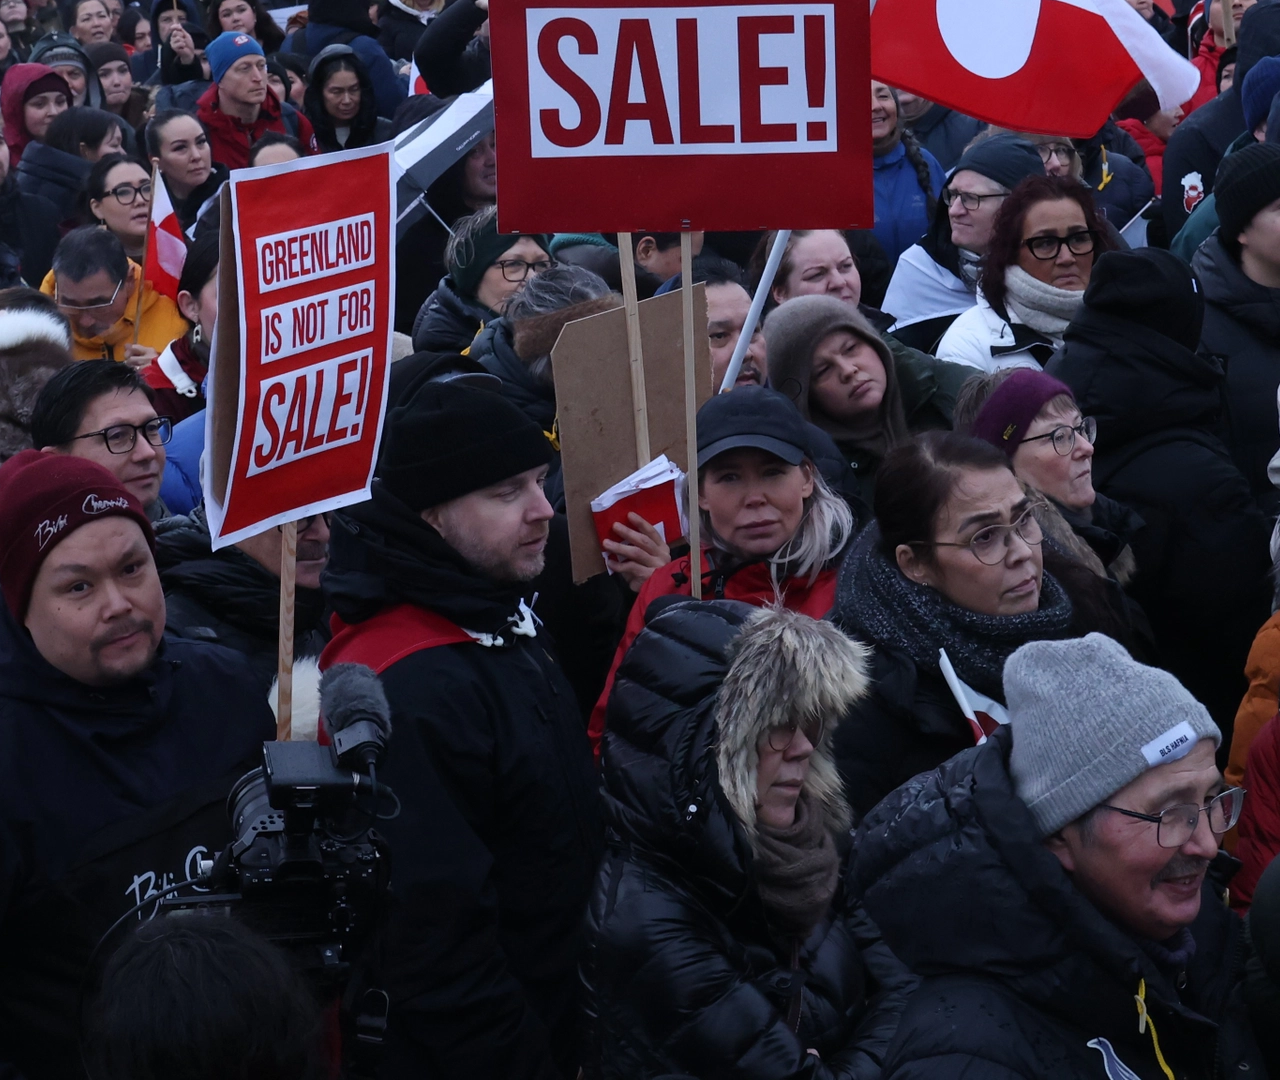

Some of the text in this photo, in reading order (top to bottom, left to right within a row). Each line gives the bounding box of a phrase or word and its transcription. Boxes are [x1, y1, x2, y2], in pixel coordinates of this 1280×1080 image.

[537, 14, 828, 148] SALE!
[260, 219, 373, 285] GREENLAND
[264, 287, 372, 356] IS NOT FOR
[253, 355, 370, 469] SALE!
[1159, 734, 1189, 757] BLS HAFNIA
